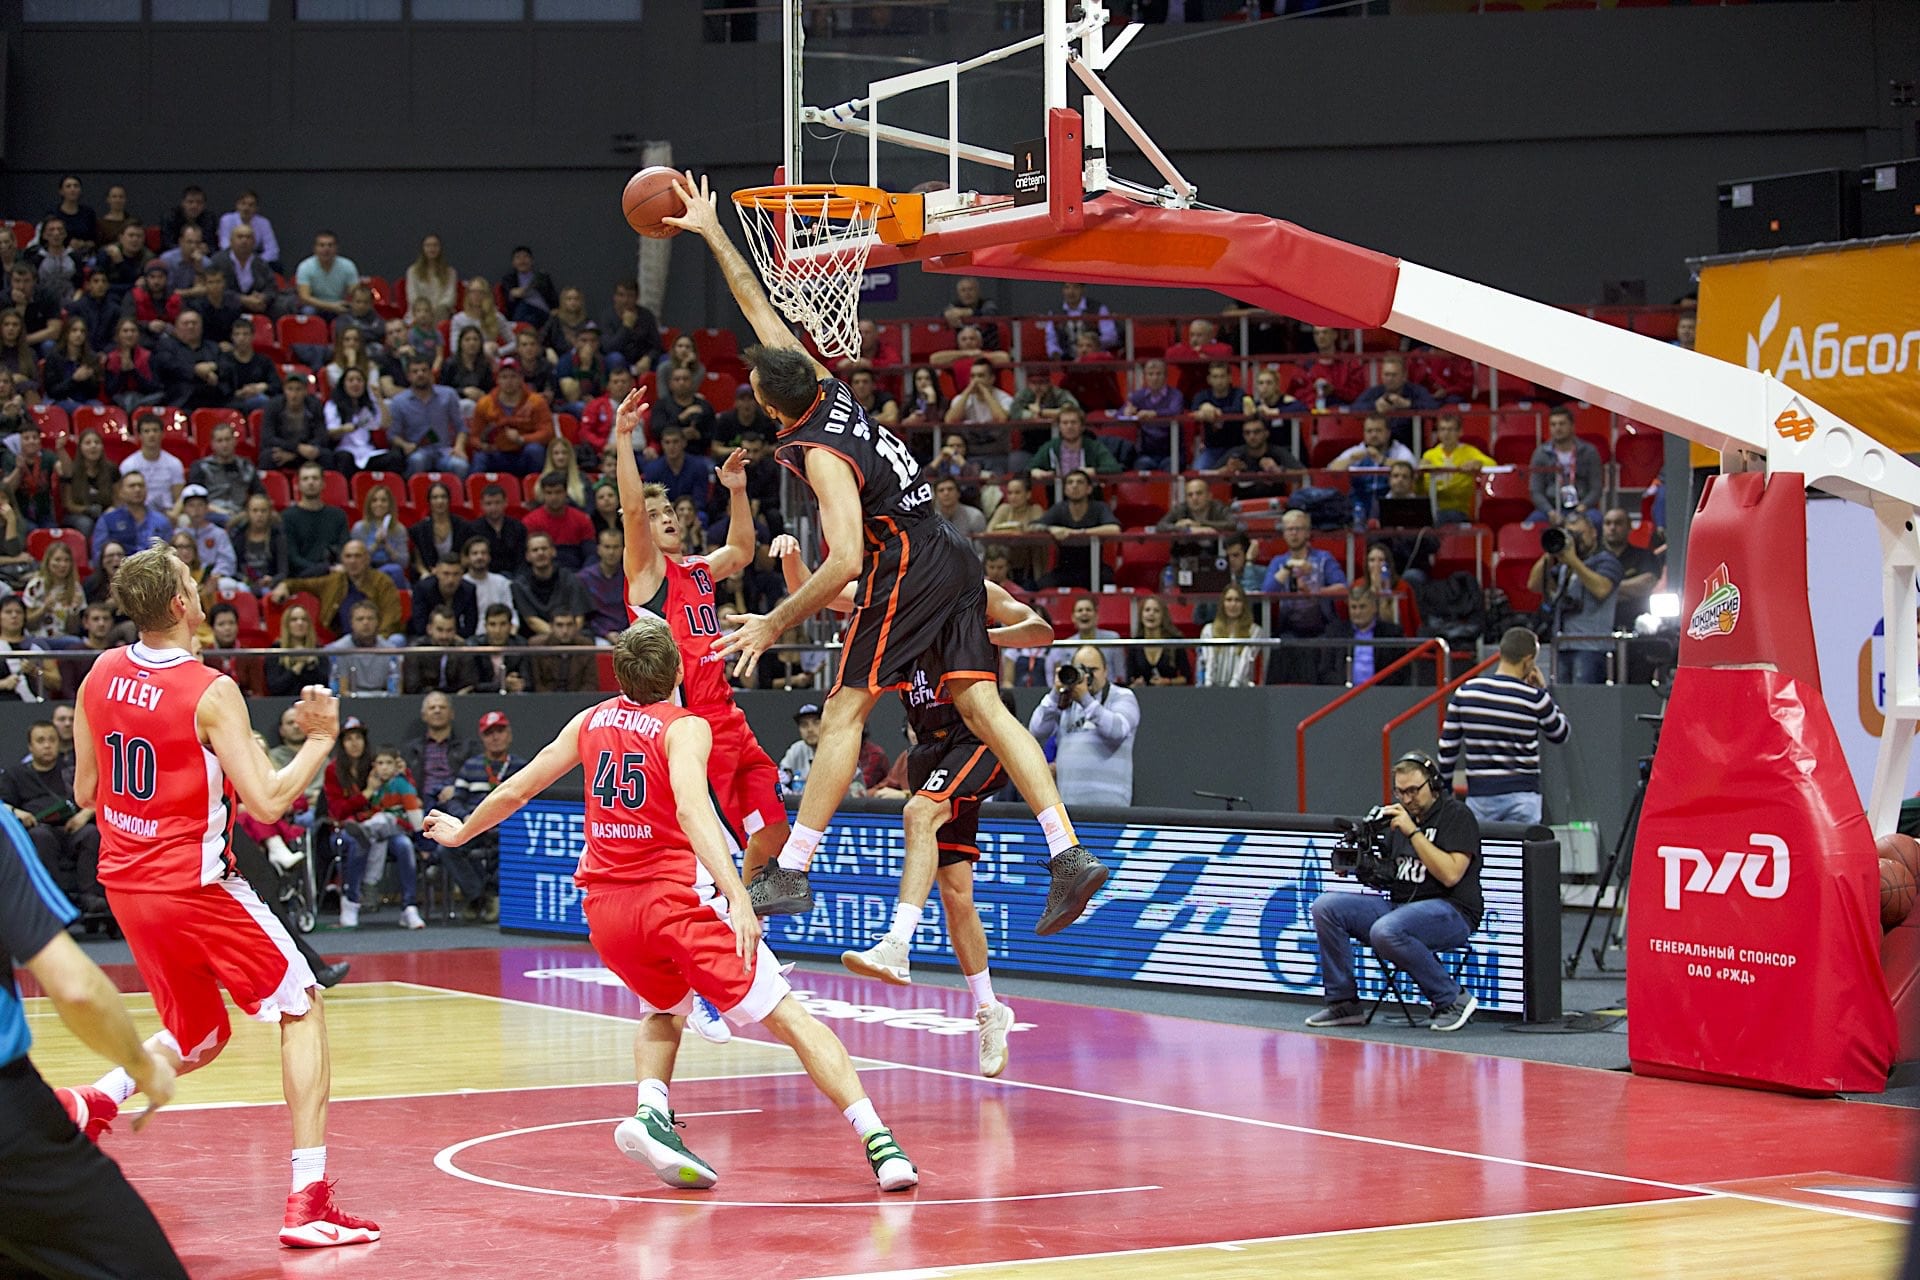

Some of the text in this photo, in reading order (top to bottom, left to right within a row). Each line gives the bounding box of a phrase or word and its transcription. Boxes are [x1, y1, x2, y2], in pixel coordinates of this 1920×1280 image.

[690, 568, 713, 596] 13
[684, 603, 721, 637] LO
[107, 676, 164, 711] IVLEV
[105, 731, 157, 801] 10
[592, 751, 647, 810] 45
[1650, 938, 1797, 968] ГЕНЕРАЛЬНЫЙ СПОНСОР
[1687, 963, 1756, 985] ОАО «РЖД»
